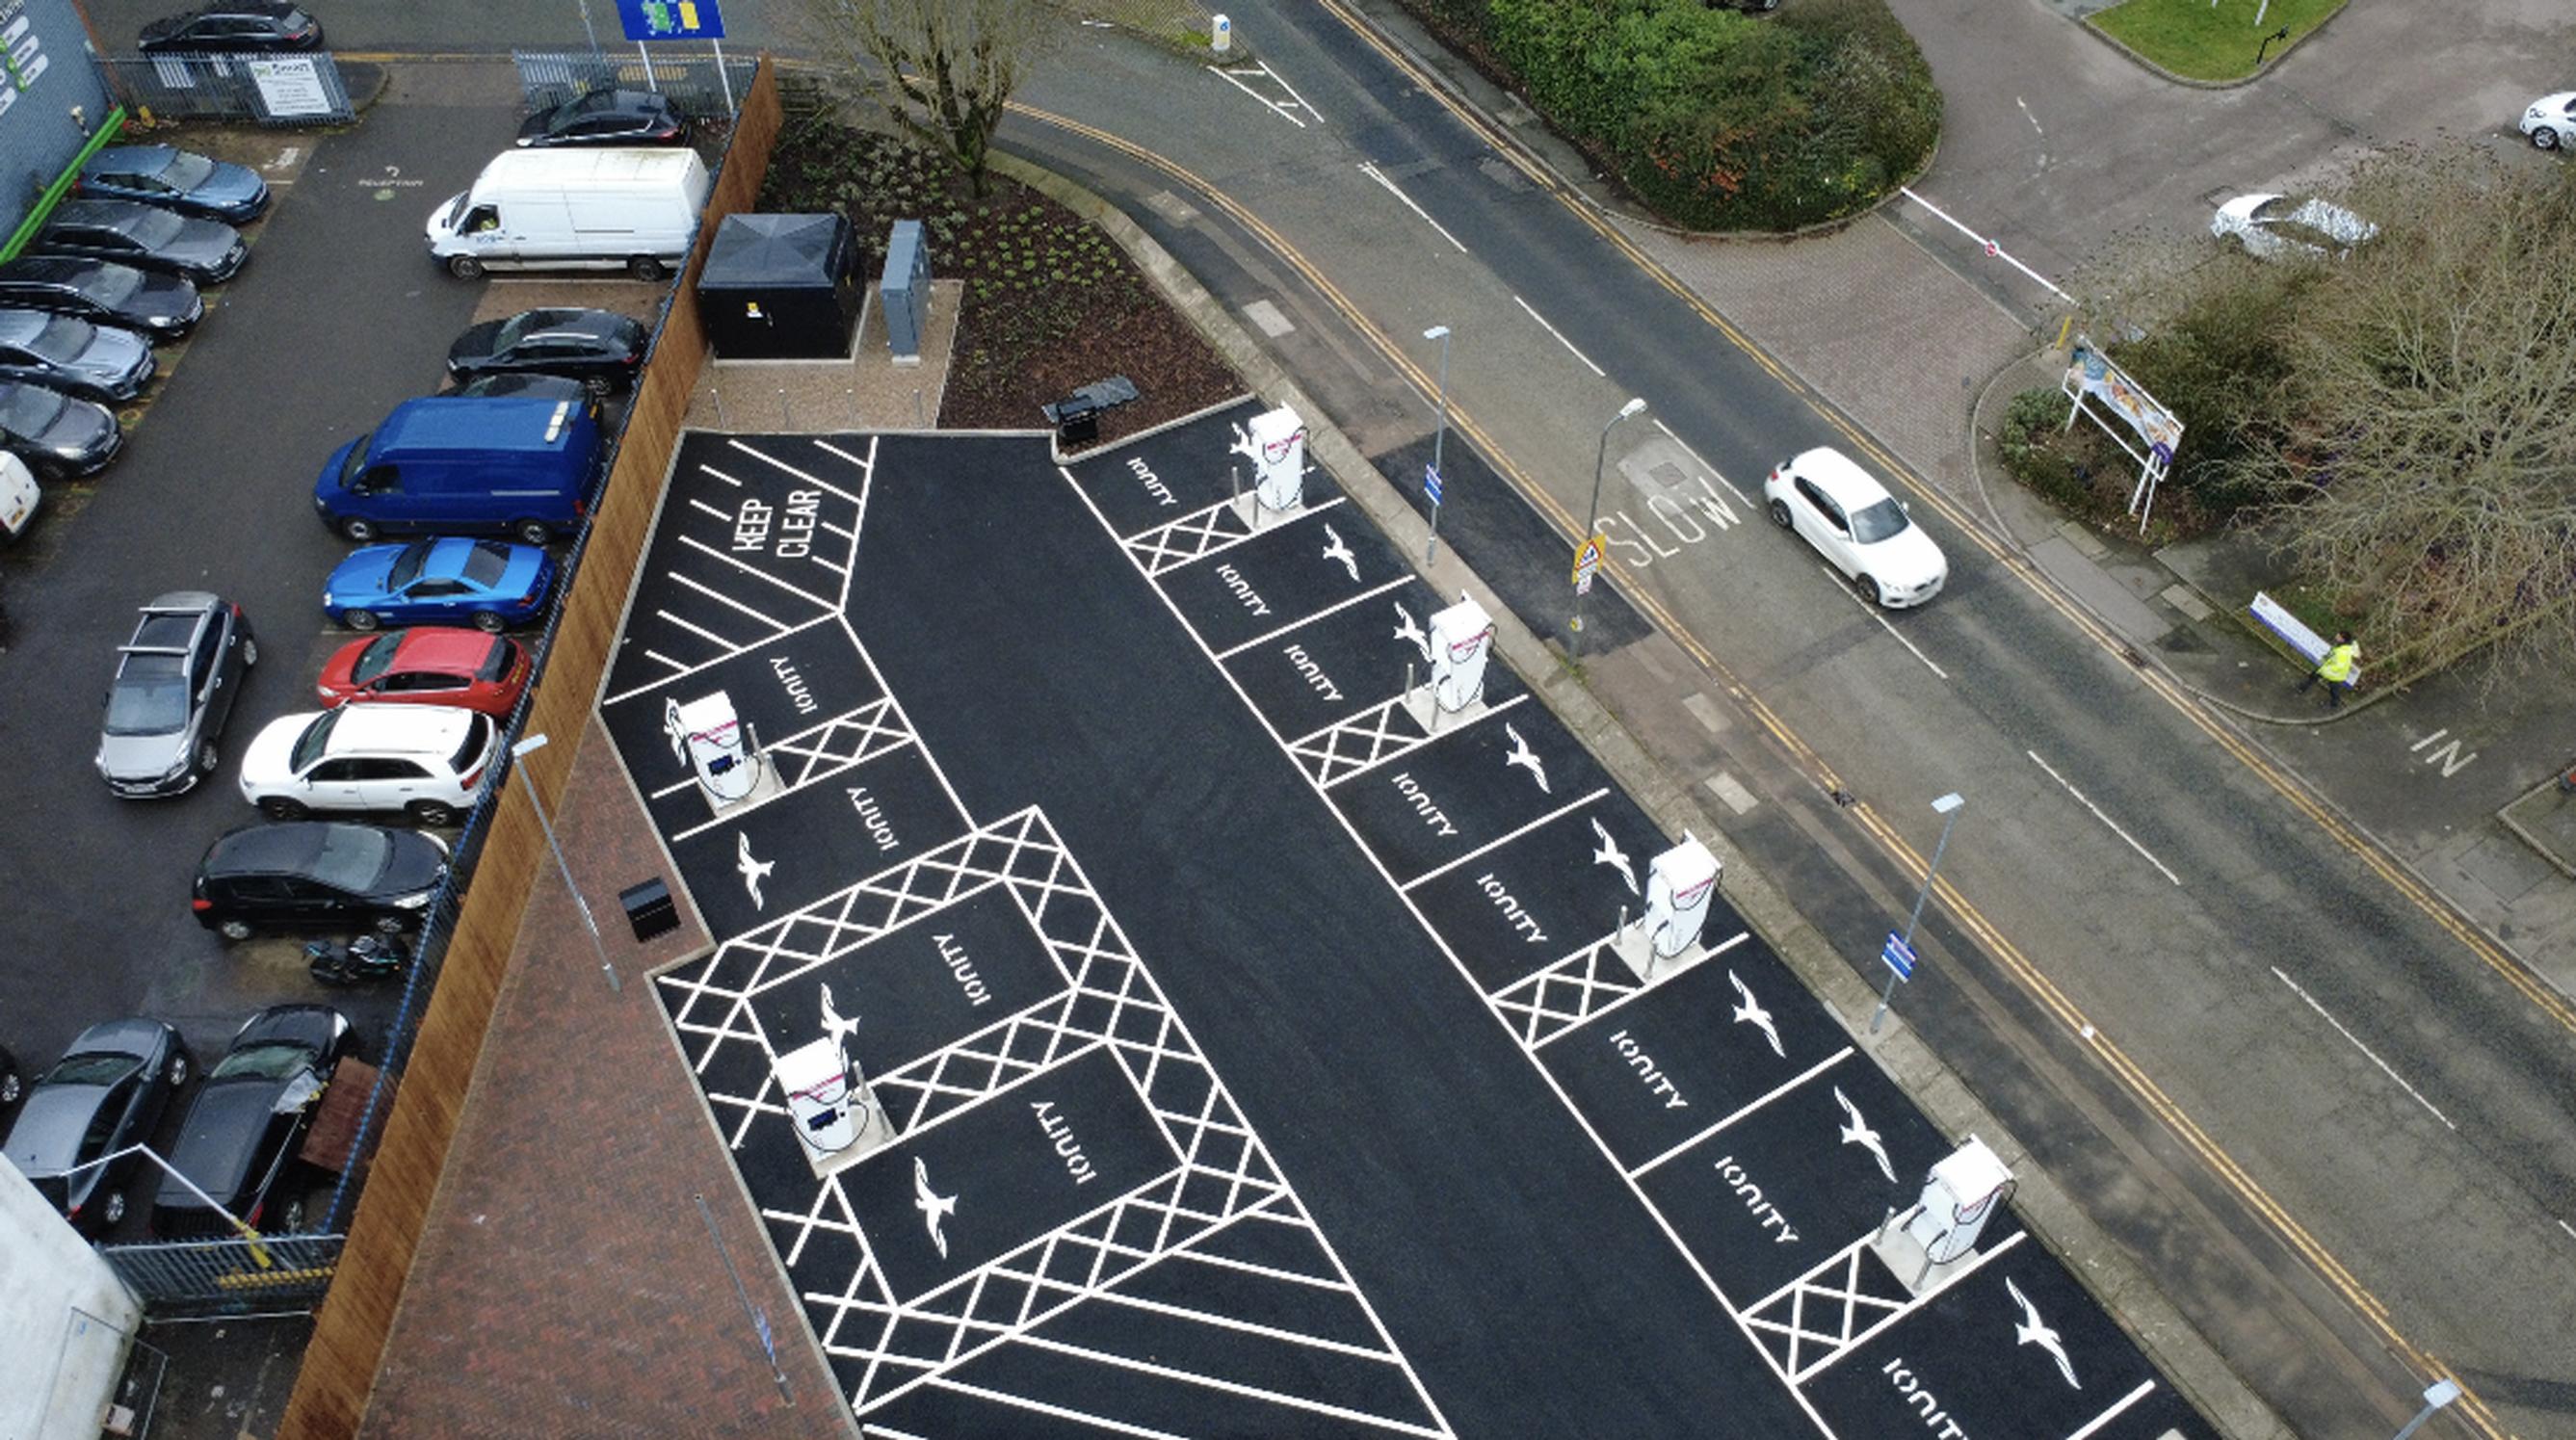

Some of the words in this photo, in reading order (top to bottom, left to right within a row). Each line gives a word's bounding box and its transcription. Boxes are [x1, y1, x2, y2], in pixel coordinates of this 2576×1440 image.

[1127, 457, 1177, 506] IONITY
[732, 499, 774, 551] KEEP
[775, 489, 823, 558] CLEAR
[1593, 476, 1742, 568] SLOW
[1216, 563, 1271, 615] IONITY
[770, 656, 818, 715] IONITY
[1283, 644, 1343, 700] IONITY
[2410, 729, 2477, 776] IN
[847, 787, 900, 851] IONITY
[1391, 772, 1459, 836] IONITY
[1477, 873, 1548, 942] IONITY
[933, 933, 991, 1006] IONITY
[1609, 1030, 1689, 1109] IONITY
[1030, 1101, 1097, 1184] IONITY
[1714, 1156, 1799, 1243] IONITY
[1882, 1357, 1969, 1440] IONIT
